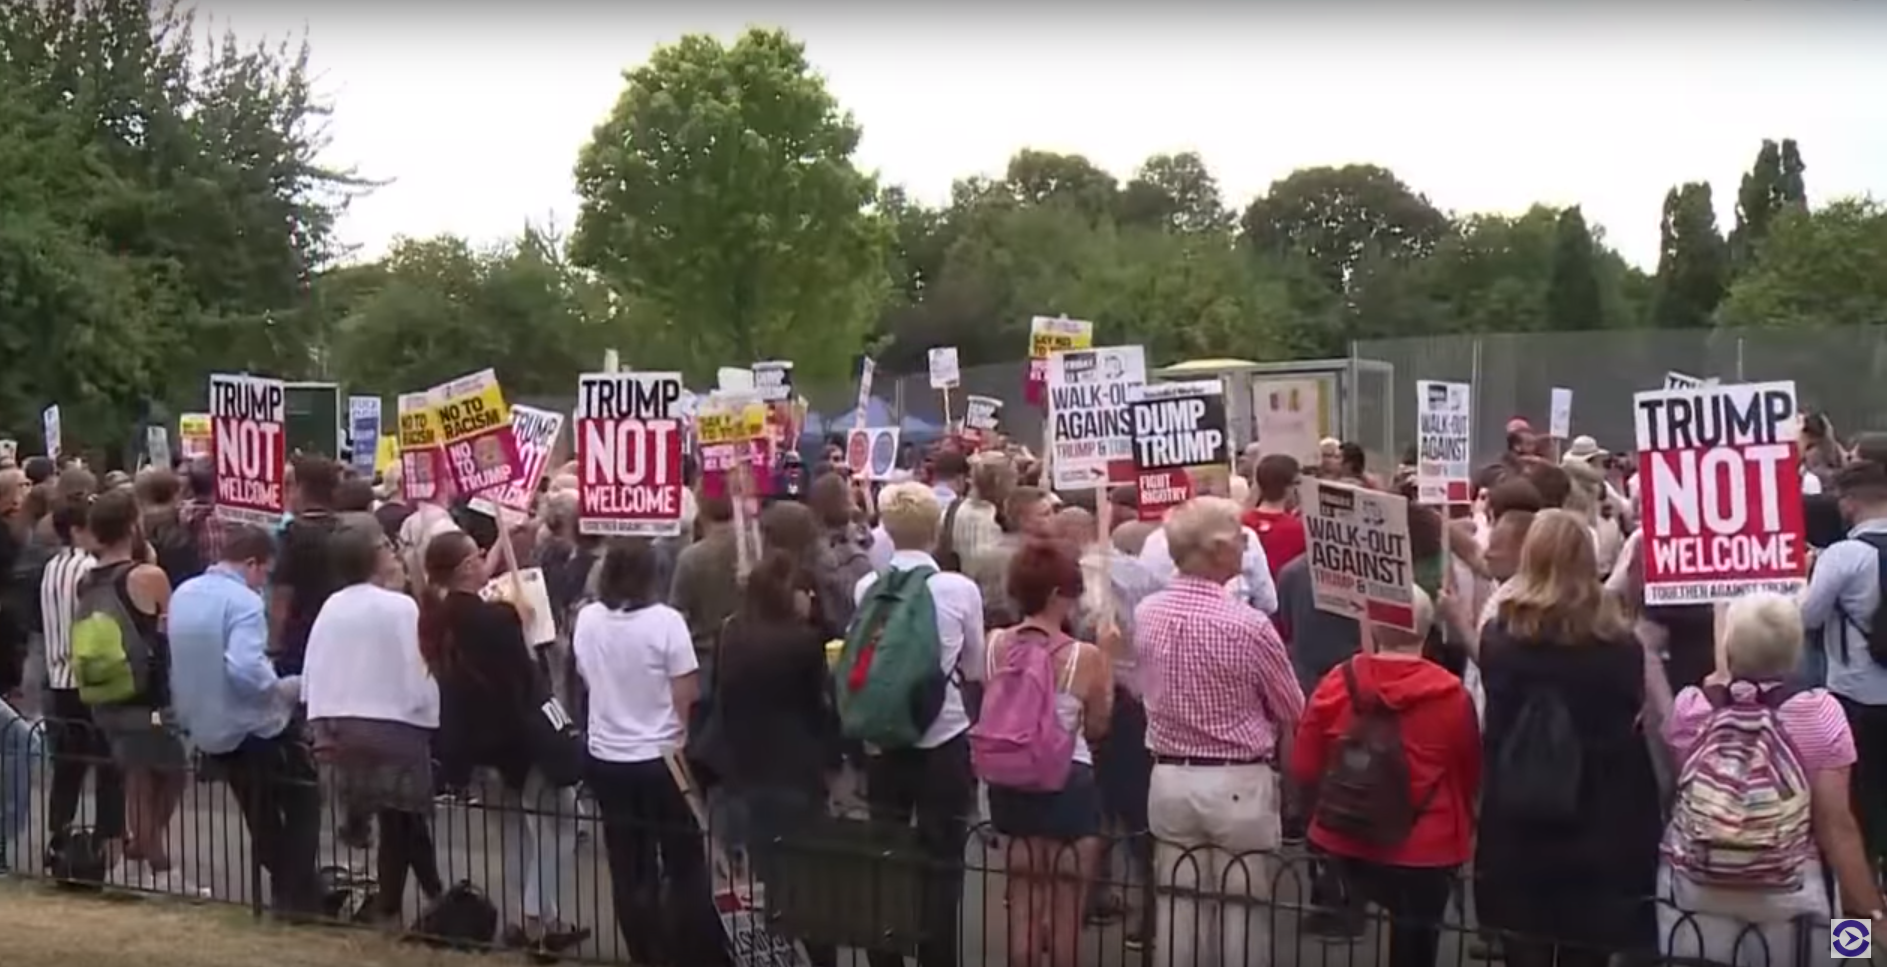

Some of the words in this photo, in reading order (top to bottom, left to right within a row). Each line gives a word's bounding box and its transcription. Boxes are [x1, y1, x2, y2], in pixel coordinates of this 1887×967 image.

[213, 380, 282, 421] TRUMP
[440, 406, 460, 422] NO
[462, 397, 484, 414] TO
[581, 379, 680, 419] TRUMP
[402, 416, 414, 429] NO
[414, 413, 428, 427] TO
[443, 408, 500, 440] RACISM
[513, 410, 557, 448] TRUMP
[1055, 408, 1132, 441] AGAINS
[1134, 399, 1206, 435] DUMP
[1421, 412, 1467, 435] WALK-OUT
[1639, 390, 1793, 450] TRUMP
[215, 417, 280, 482] NOT
[451, 441, 472, 464] NO
[585, 419, 677, 485] NOT
[1056, 441, 1096, 458] TRUMP
[1136, 429, 1222, 467] TRUMP
[1421, 436, 1467, 461] AGAINST
[456, 460, 476, 477] TO
[459, 463, 513, 494] TRUMP
[1139, 473, 1171, 490] FIGHT
[217, 475, 281, 509] WELCOME
[583, 484, 676, 514] WELCOME
[1140, 486, 1188, 505] BIGOTRY
[1651, 443, 1790, 537] NOT
[1307, 515, 1405, 558] WALK-OUT
[1313, 541, 1406, 586] AGAINST
[1652, 532, 1798, 575] WELCOME
[1651, 584, 1709, 602] TOGETHER
[1710, 582, 1757, 598] AGAINST
